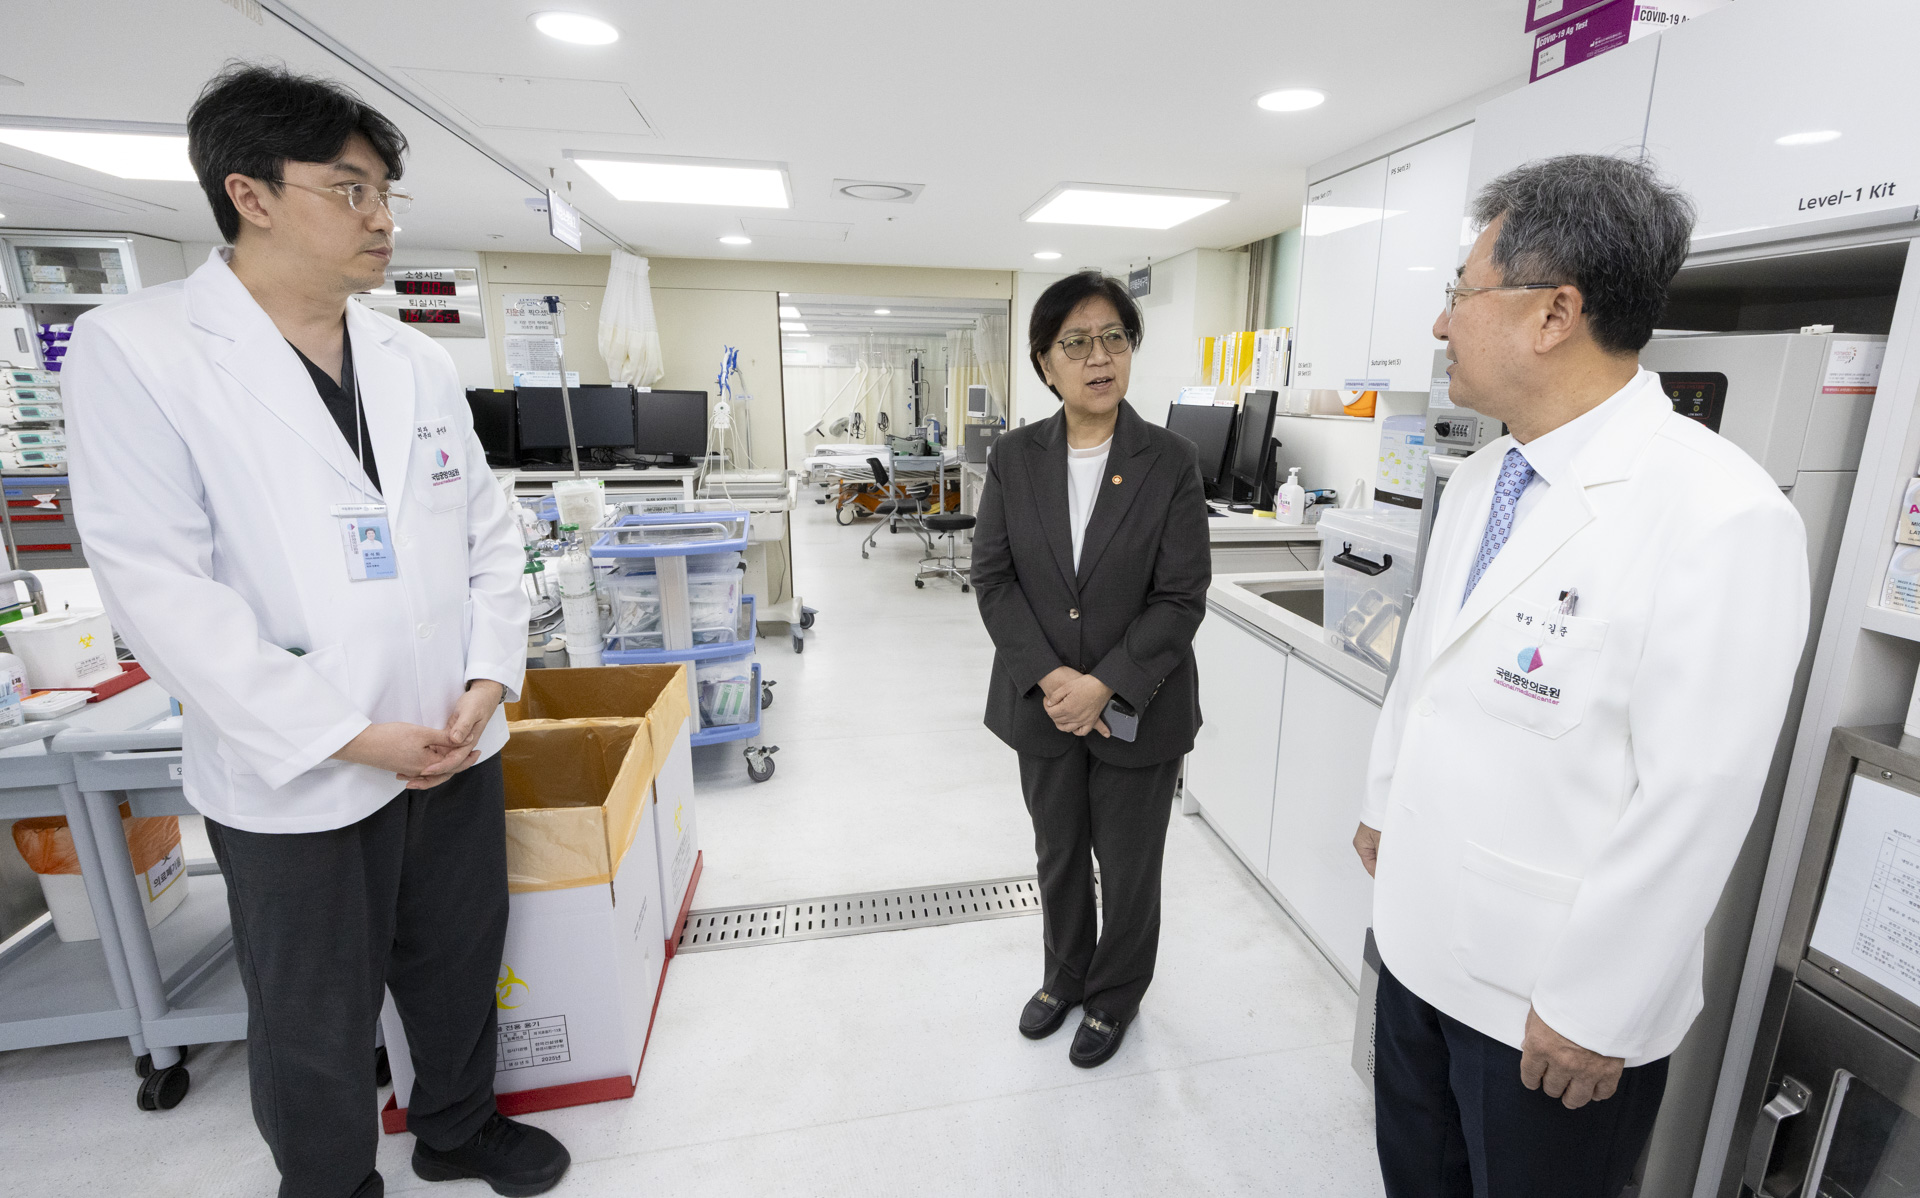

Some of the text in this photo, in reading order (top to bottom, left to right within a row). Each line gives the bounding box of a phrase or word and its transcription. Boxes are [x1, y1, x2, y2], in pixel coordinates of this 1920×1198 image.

[1640, 10, 1690, 25] COVID-19 A
[1539, 31, 1565, 46] COVID-19
[1566, 26, 1574, 36] Ag
[1575, 19, 1589, 31] Test
[1798, 182, 1896, 211] Level-1 Kit
[405, 271, 443, 280] 소생시간
[408, 299, 447, 308] 퇴실시각
[1371, 359, 1388, 367] Suturing
[431, 468, 460, 481] 국립중앙의료원
[1516, 612, 1533, 626] 원장
[1496, 667, 1561, 699] 국립중앙의료원
[153, 856, 182, 888] 의료폐기물
[505, 1023, 521, 1032] 전용
[524, 1021, 540, 1029] 용기
[541, 1055, 561, 1063] 2025년
